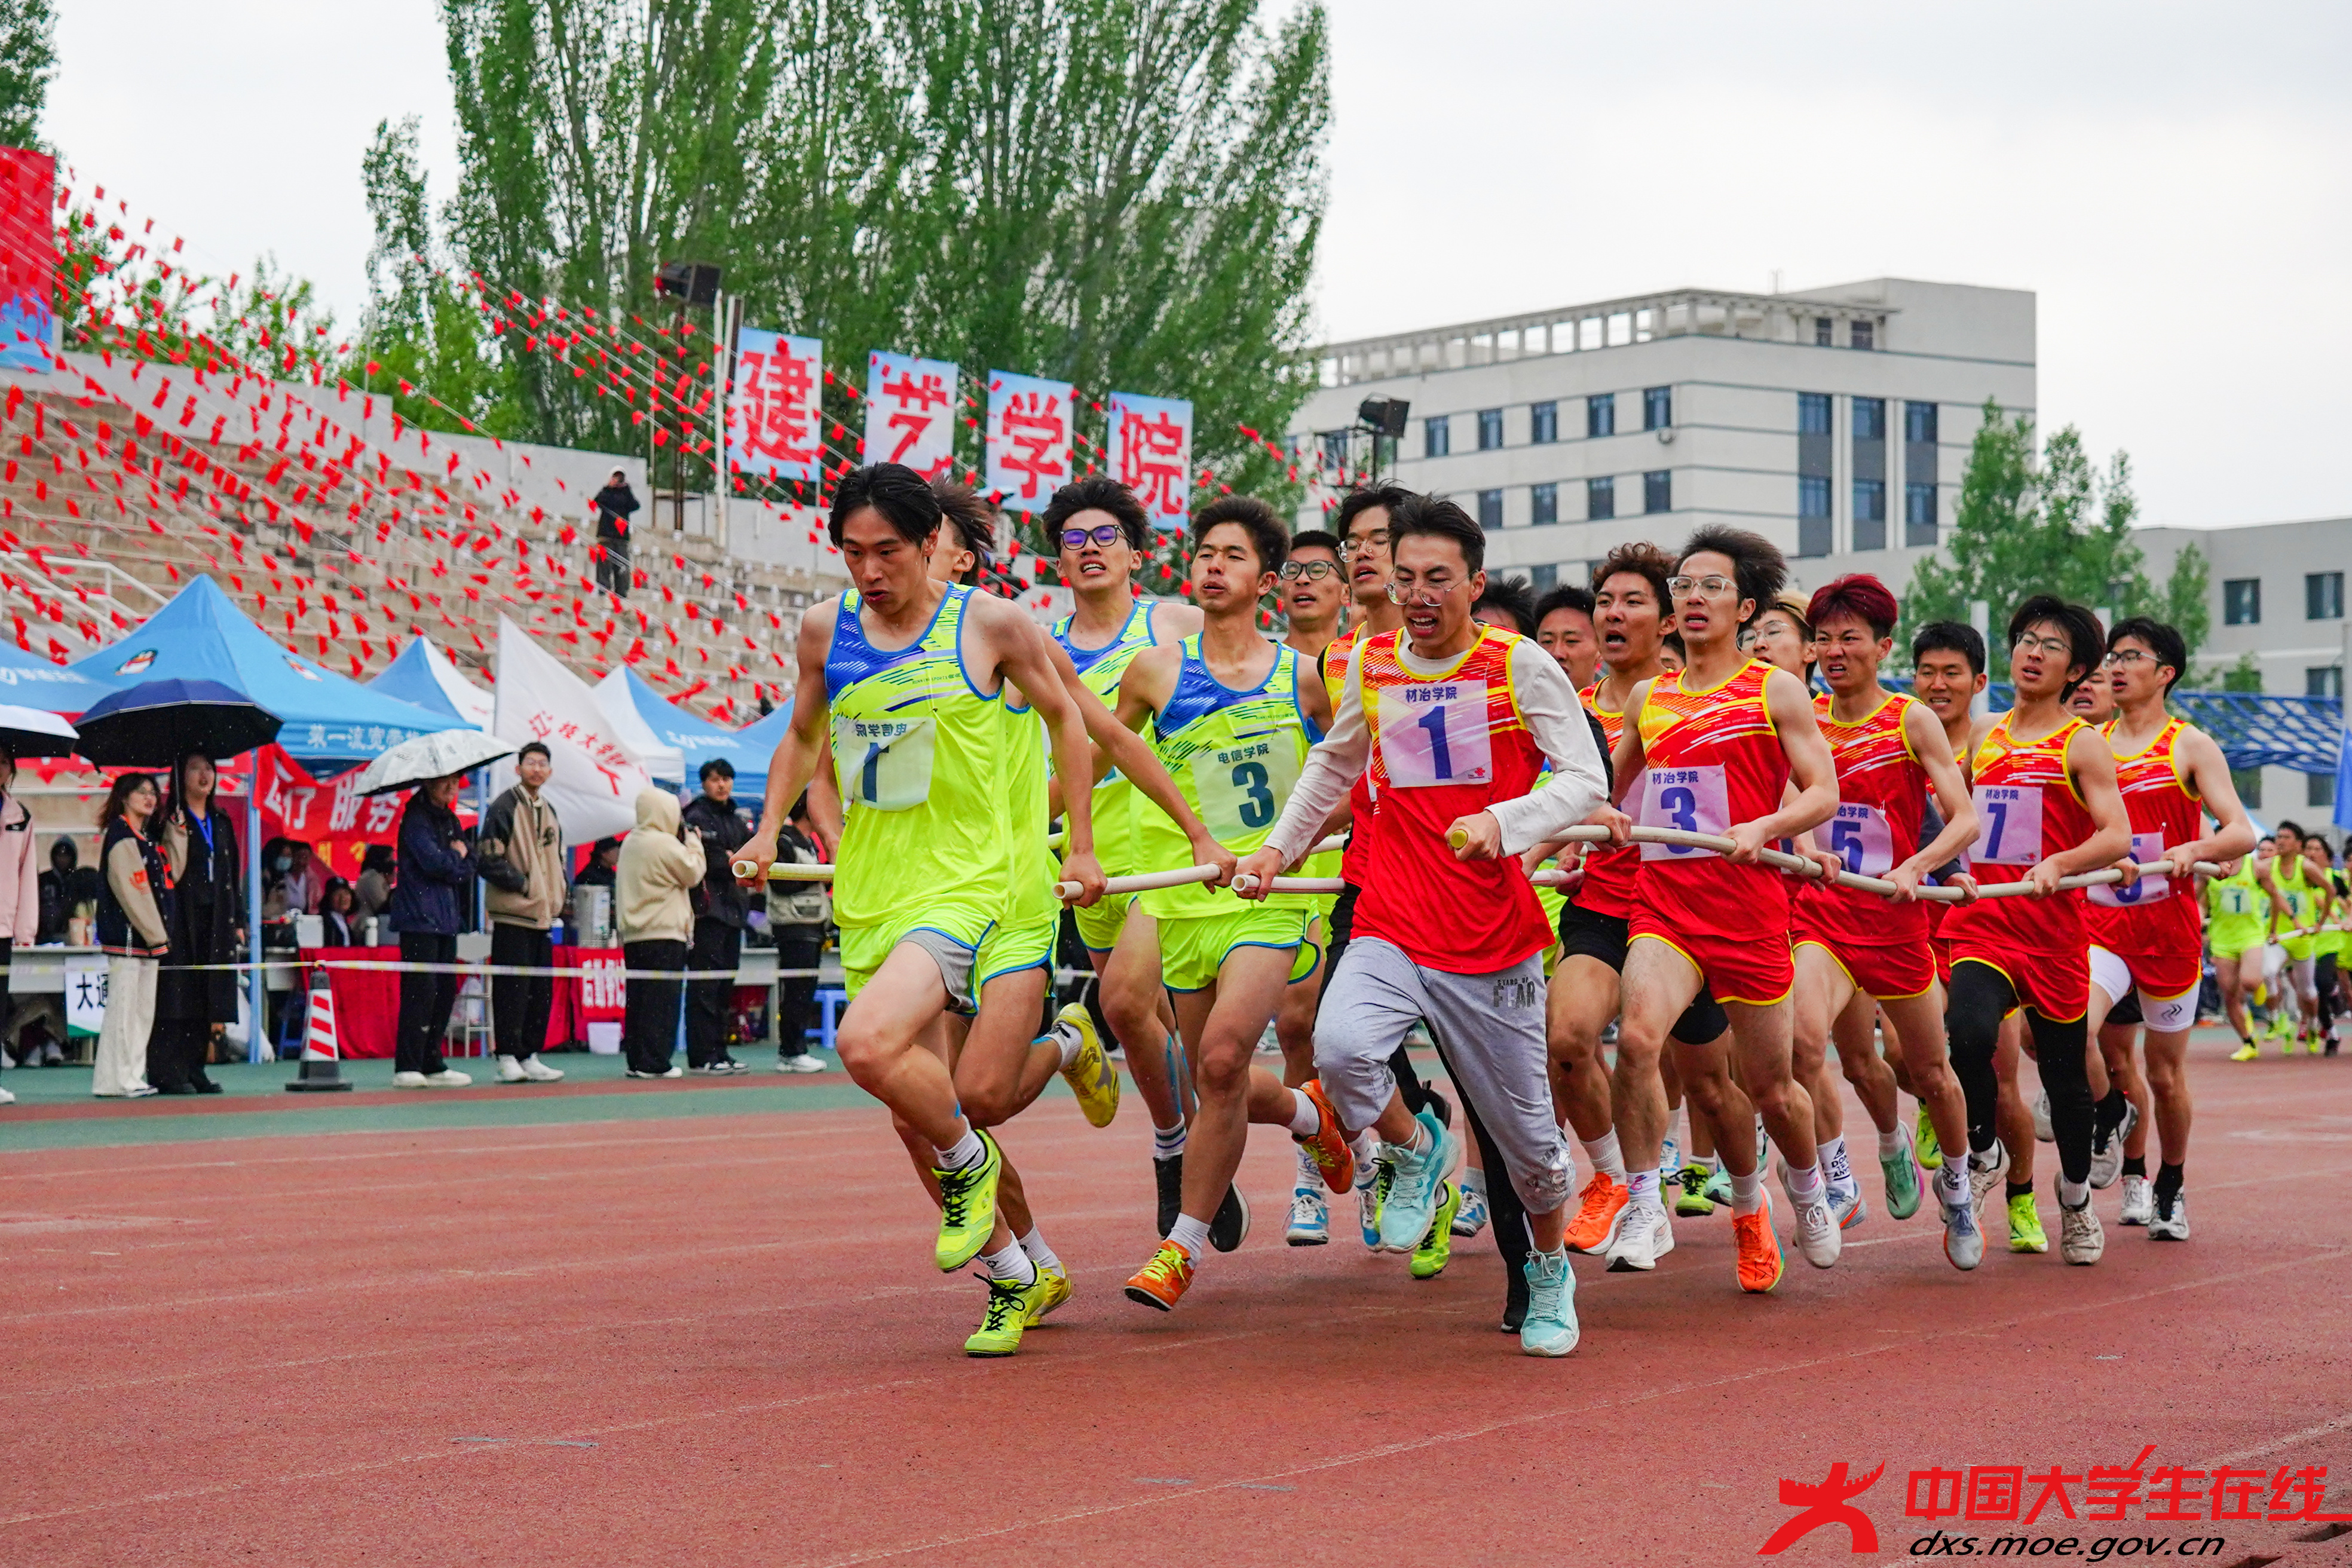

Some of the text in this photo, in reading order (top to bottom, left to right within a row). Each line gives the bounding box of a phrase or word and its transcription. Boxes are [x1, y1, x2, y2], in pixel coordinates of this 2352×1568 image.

[1405, 686, 1457, 703] 材冶学院
[1218, 743, 1270, 764] 电信学院
[1419, 706, 1452, 779] 1
[1232, 761, 1275, 828] 3
[1652, 770, 1699, 785] 材冶学院
[1660, 786, 1697, 855] 3
[1832, 820, 1863, 875] 5
[1984, 803, 2007, 859] 7
